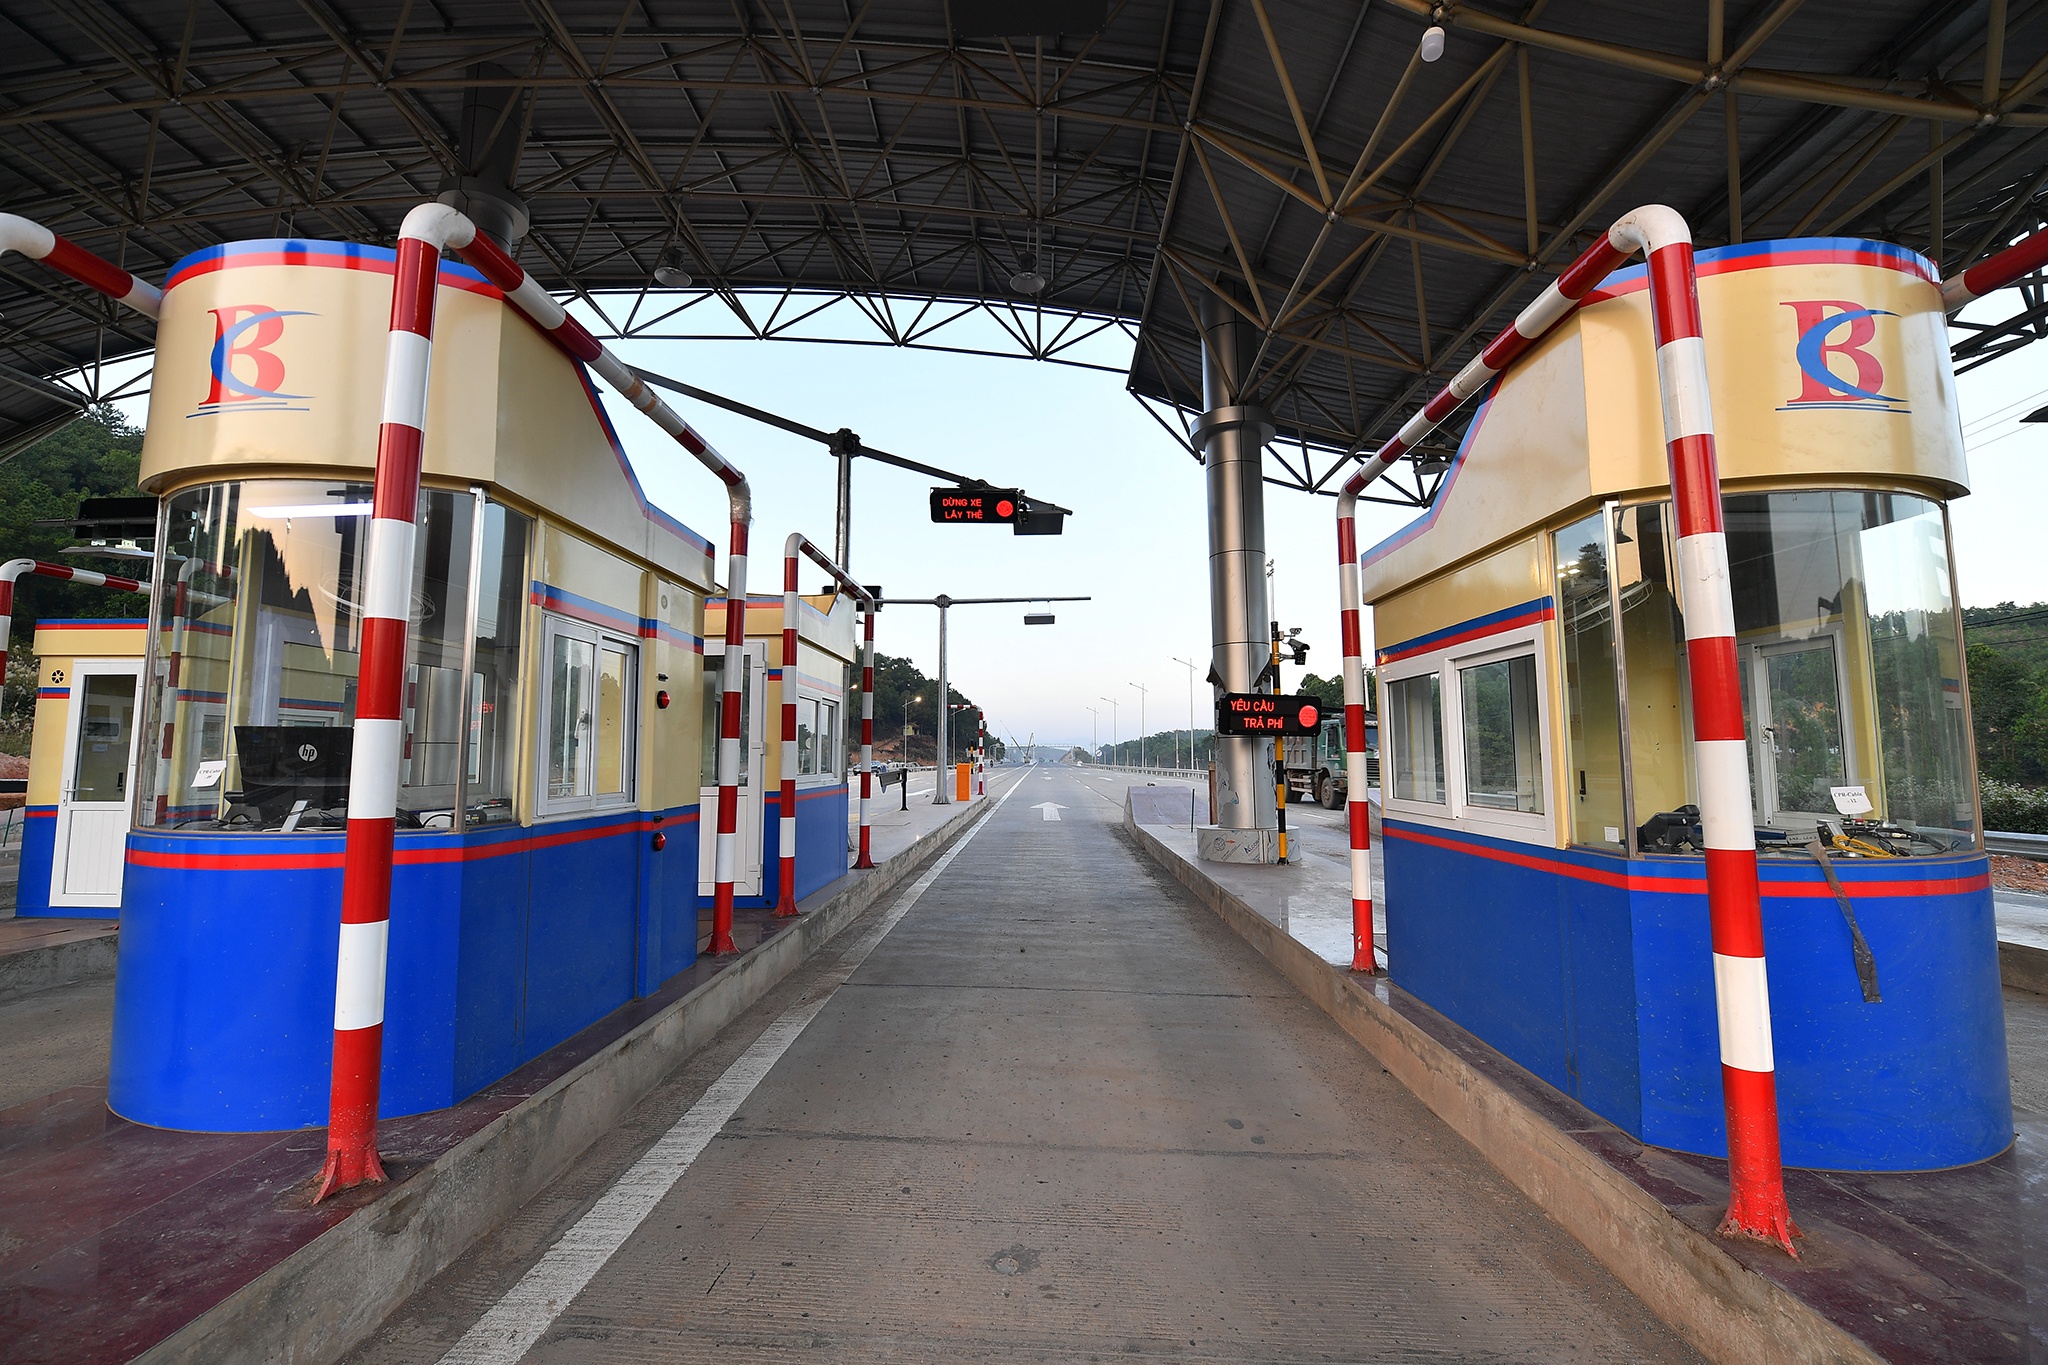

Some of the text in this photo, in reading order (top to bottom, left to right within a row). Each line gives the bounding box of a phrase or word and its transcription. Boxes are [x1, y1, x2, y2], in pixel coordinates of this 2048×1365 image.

[970, 498, 982, 507] XE
[1230, 698, 1251, 711] YÊU
[1267, 716, 1284, 729] PHÍ
[299, 744, 318, 761] hp
